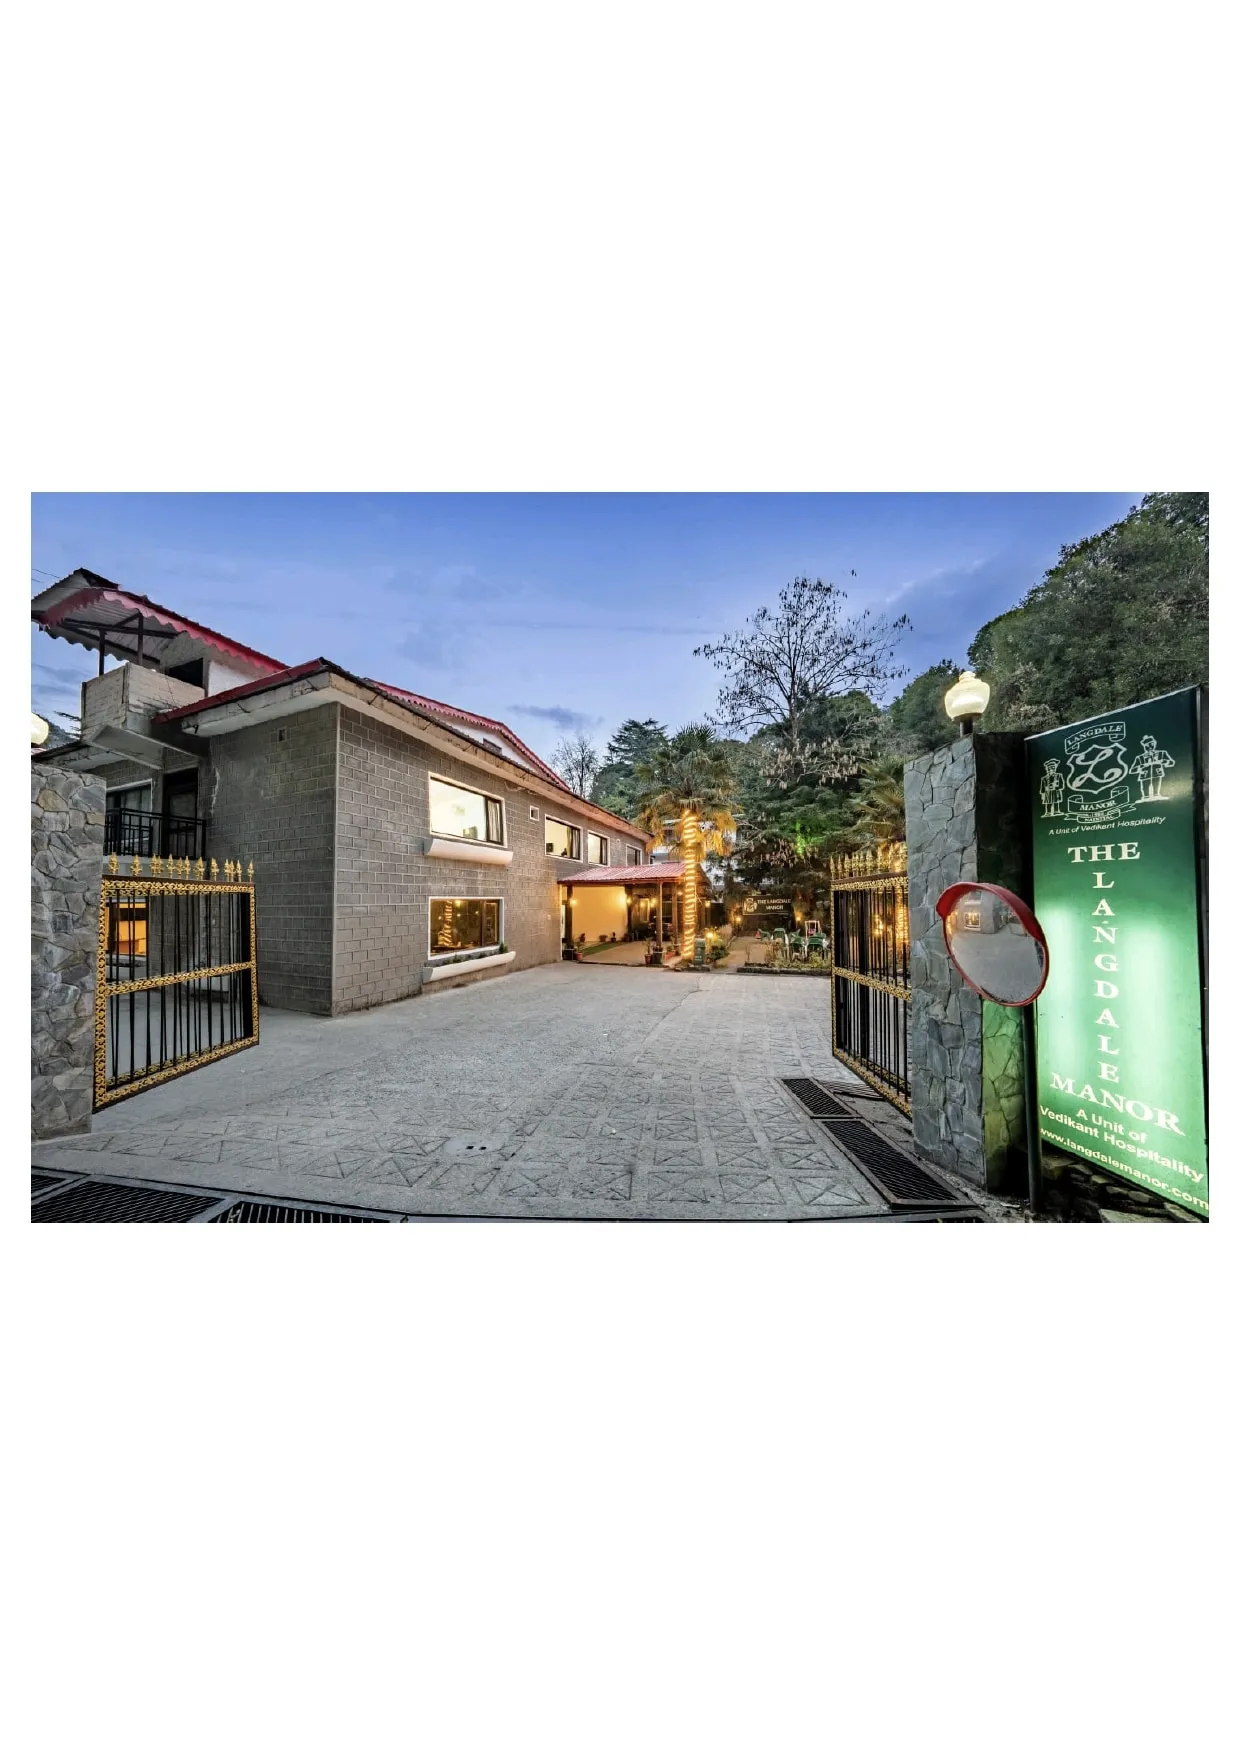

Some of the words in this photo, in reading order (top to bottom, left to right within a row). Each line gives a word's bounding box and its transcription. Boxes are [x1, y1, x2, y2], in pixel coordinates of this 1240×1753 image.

[1067, 725, 1123, 745] LANGDALE
[1080, 799, 1117, 811] MANOR
[1080, 822, 1116, 832] Vedikant
[1117, 816, 1167, 828] Hospitality
[1067, 841, 1140, 863] THE
[1092, 871, 1120, 1084] LANGDALE
[1049, 1072, 1186, 1137] MANOR
[1075, 1108, 1088, 1121] A
[1091, 1113, 1125, 1136] Unit
[1128, 1130, 1148, 1144] of
[1040, 1105, 1100, 1139] Vedikant
[1103, 1132, 1205, 1184] Hospitality
[1040, 1128, 1209, 1211] www.langdalemanor.com
